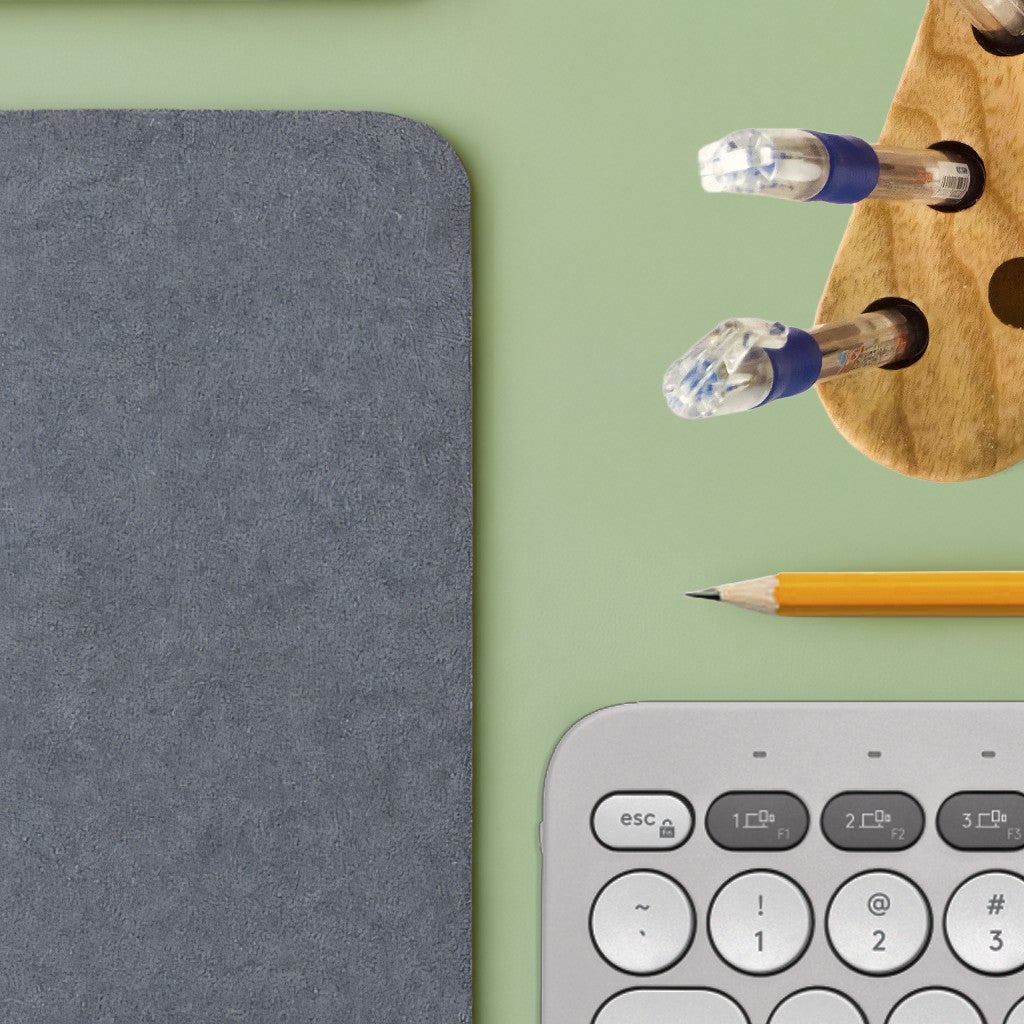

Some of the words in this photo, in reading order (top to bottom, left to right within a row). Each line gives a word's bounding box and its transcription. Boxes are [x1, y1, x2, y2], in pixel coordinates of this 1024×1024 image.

[620, 812, 656, 827] esc
[732, 812, 740, 829] 1
[844, 812, 856, 829] 2
[961, 812, 973, 829] 3
[777, 827, 790, 840] F1
[890, 827, 906, 840] F2
[1006, 827, 1022, 840] F3
[757, 894, 764, 917] !
[867, 892, 891, 917] @
[986, 893, 1006, 915] #
[754, 930, 764, 952] 1
[872, 929, 886, 952] 2
[989, 929, 1004, 952] 3
